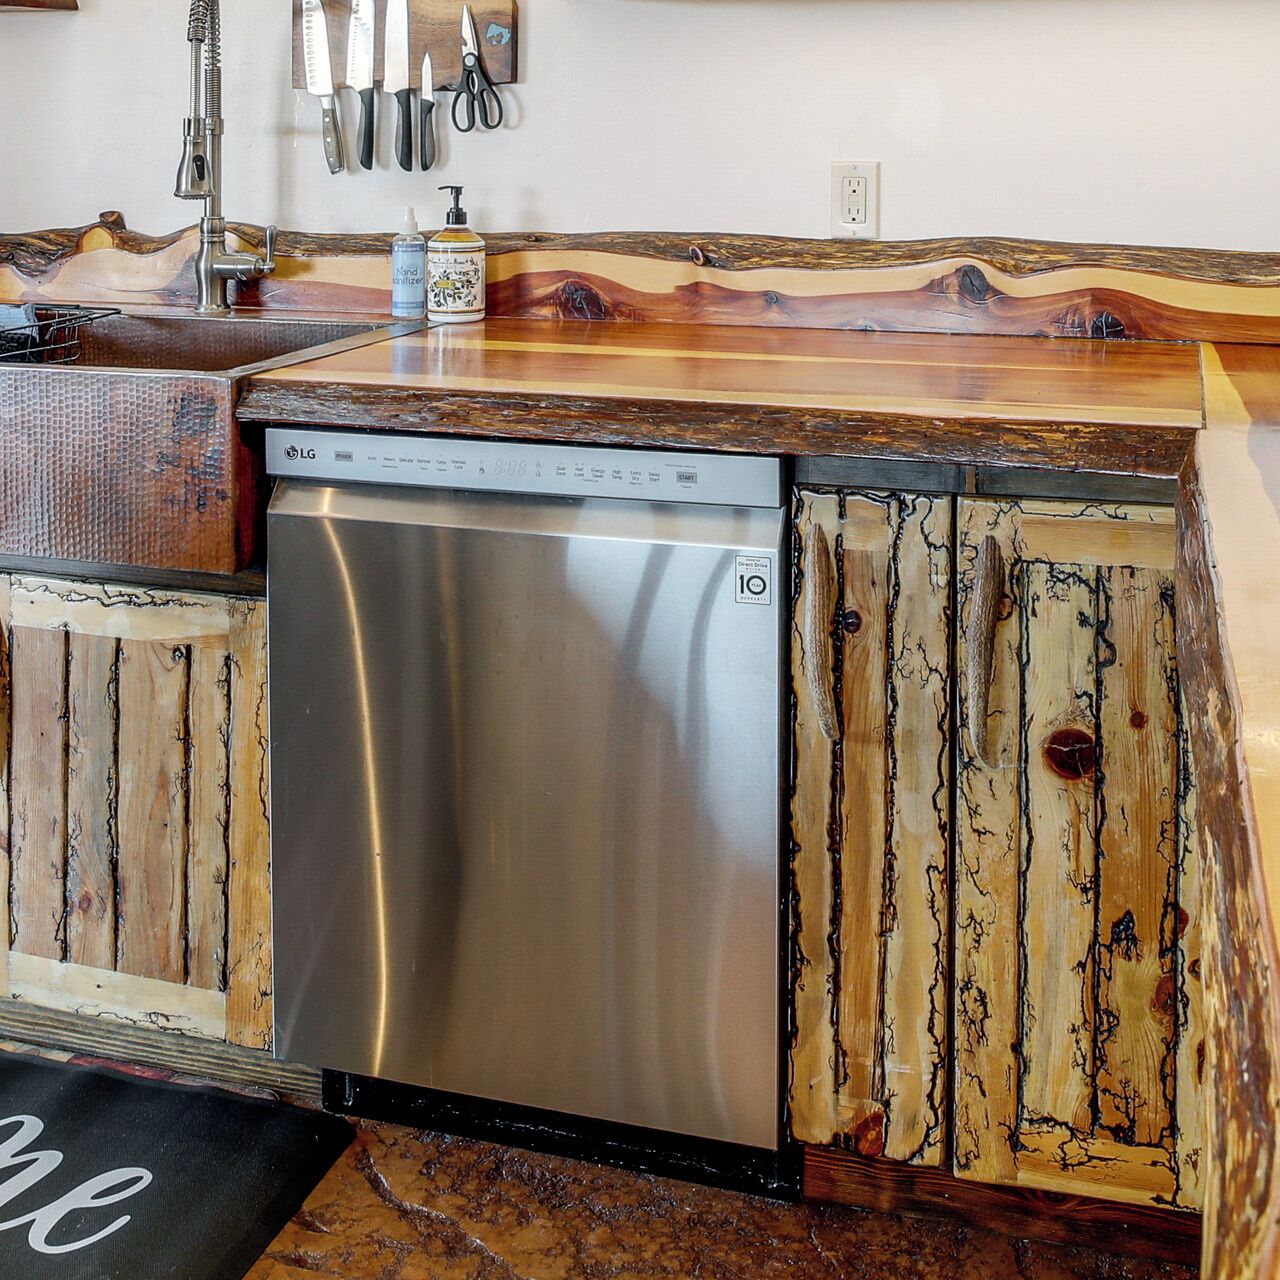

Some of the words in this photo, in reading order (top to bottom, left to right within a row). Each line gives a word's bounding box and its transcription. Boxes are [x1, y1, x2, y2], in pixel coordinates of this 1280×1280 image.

[396, 267, 418, 277] hand
[300, 448, 316, 459] LG
[739, 574, 767, 595] 10
